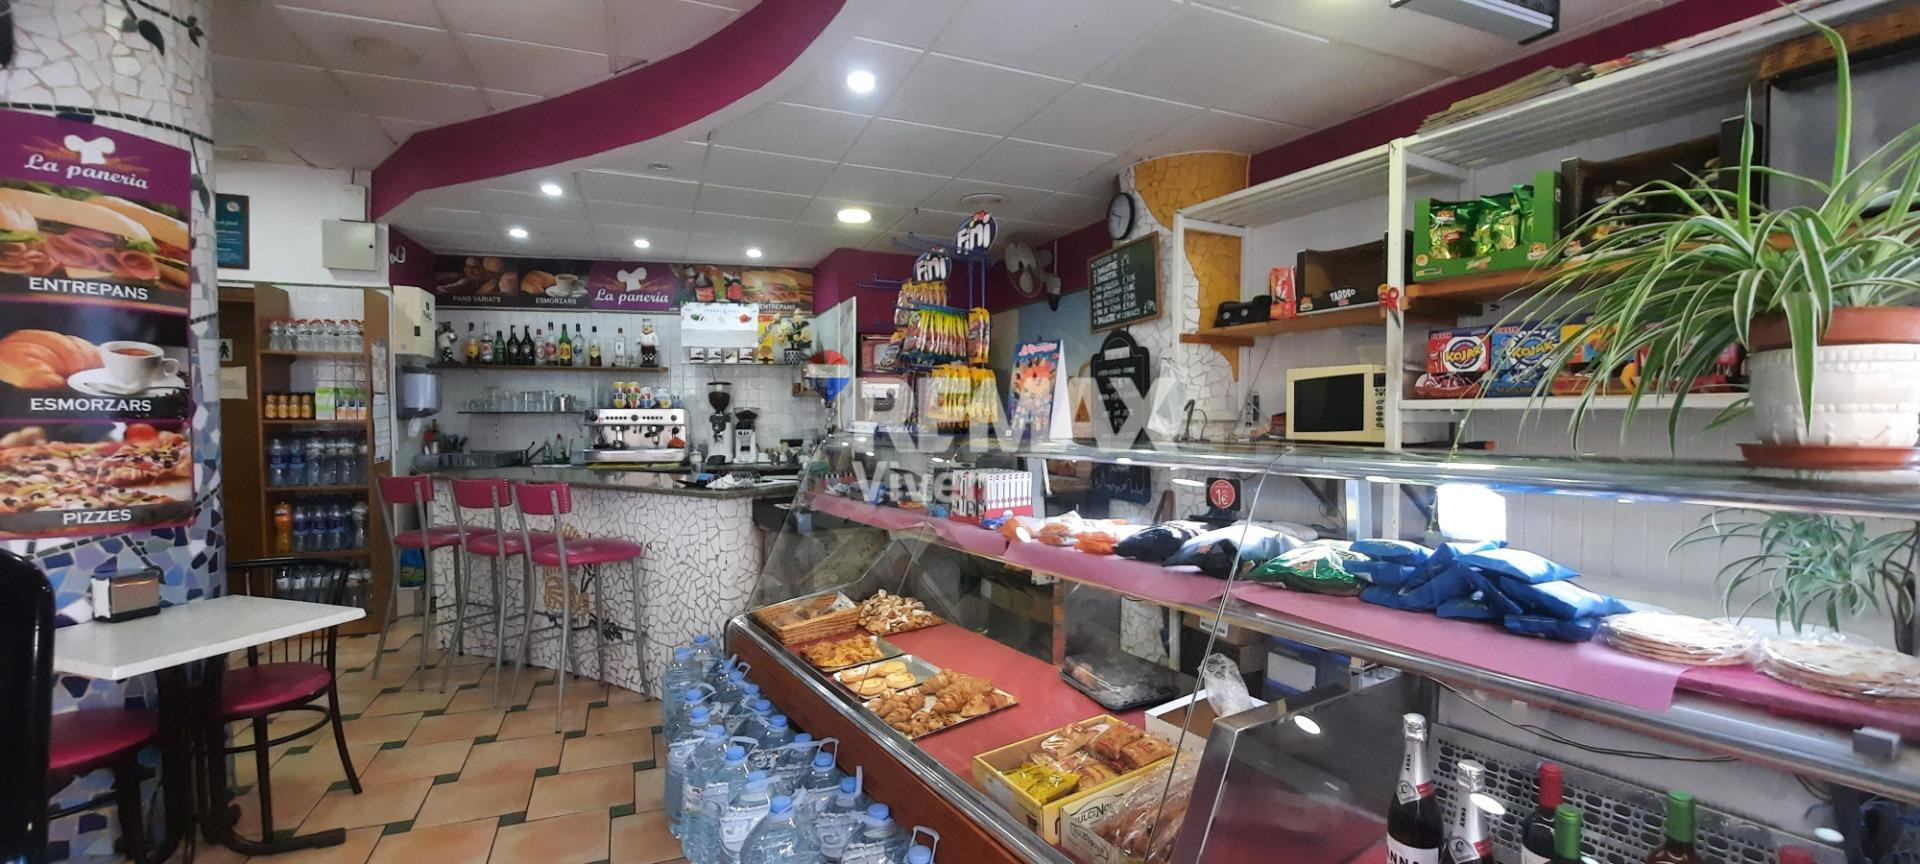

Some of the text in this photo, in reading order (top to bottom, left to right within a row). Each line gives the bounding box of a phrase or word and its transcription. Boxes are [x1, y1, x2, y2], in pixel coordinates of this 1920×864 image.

[24, 152, 149, 191] La paneria
[29, 276, 149, 301] ENTREPANS
[594, 288, 669, 305] La paneria
[535, 297, 577, 305] ESMORZARS
[1443, 345, 1483, 363] KOJAK
[30, 397, 152, 413] ESMORZARS
[63, 508, 132, 526] PIZZES
